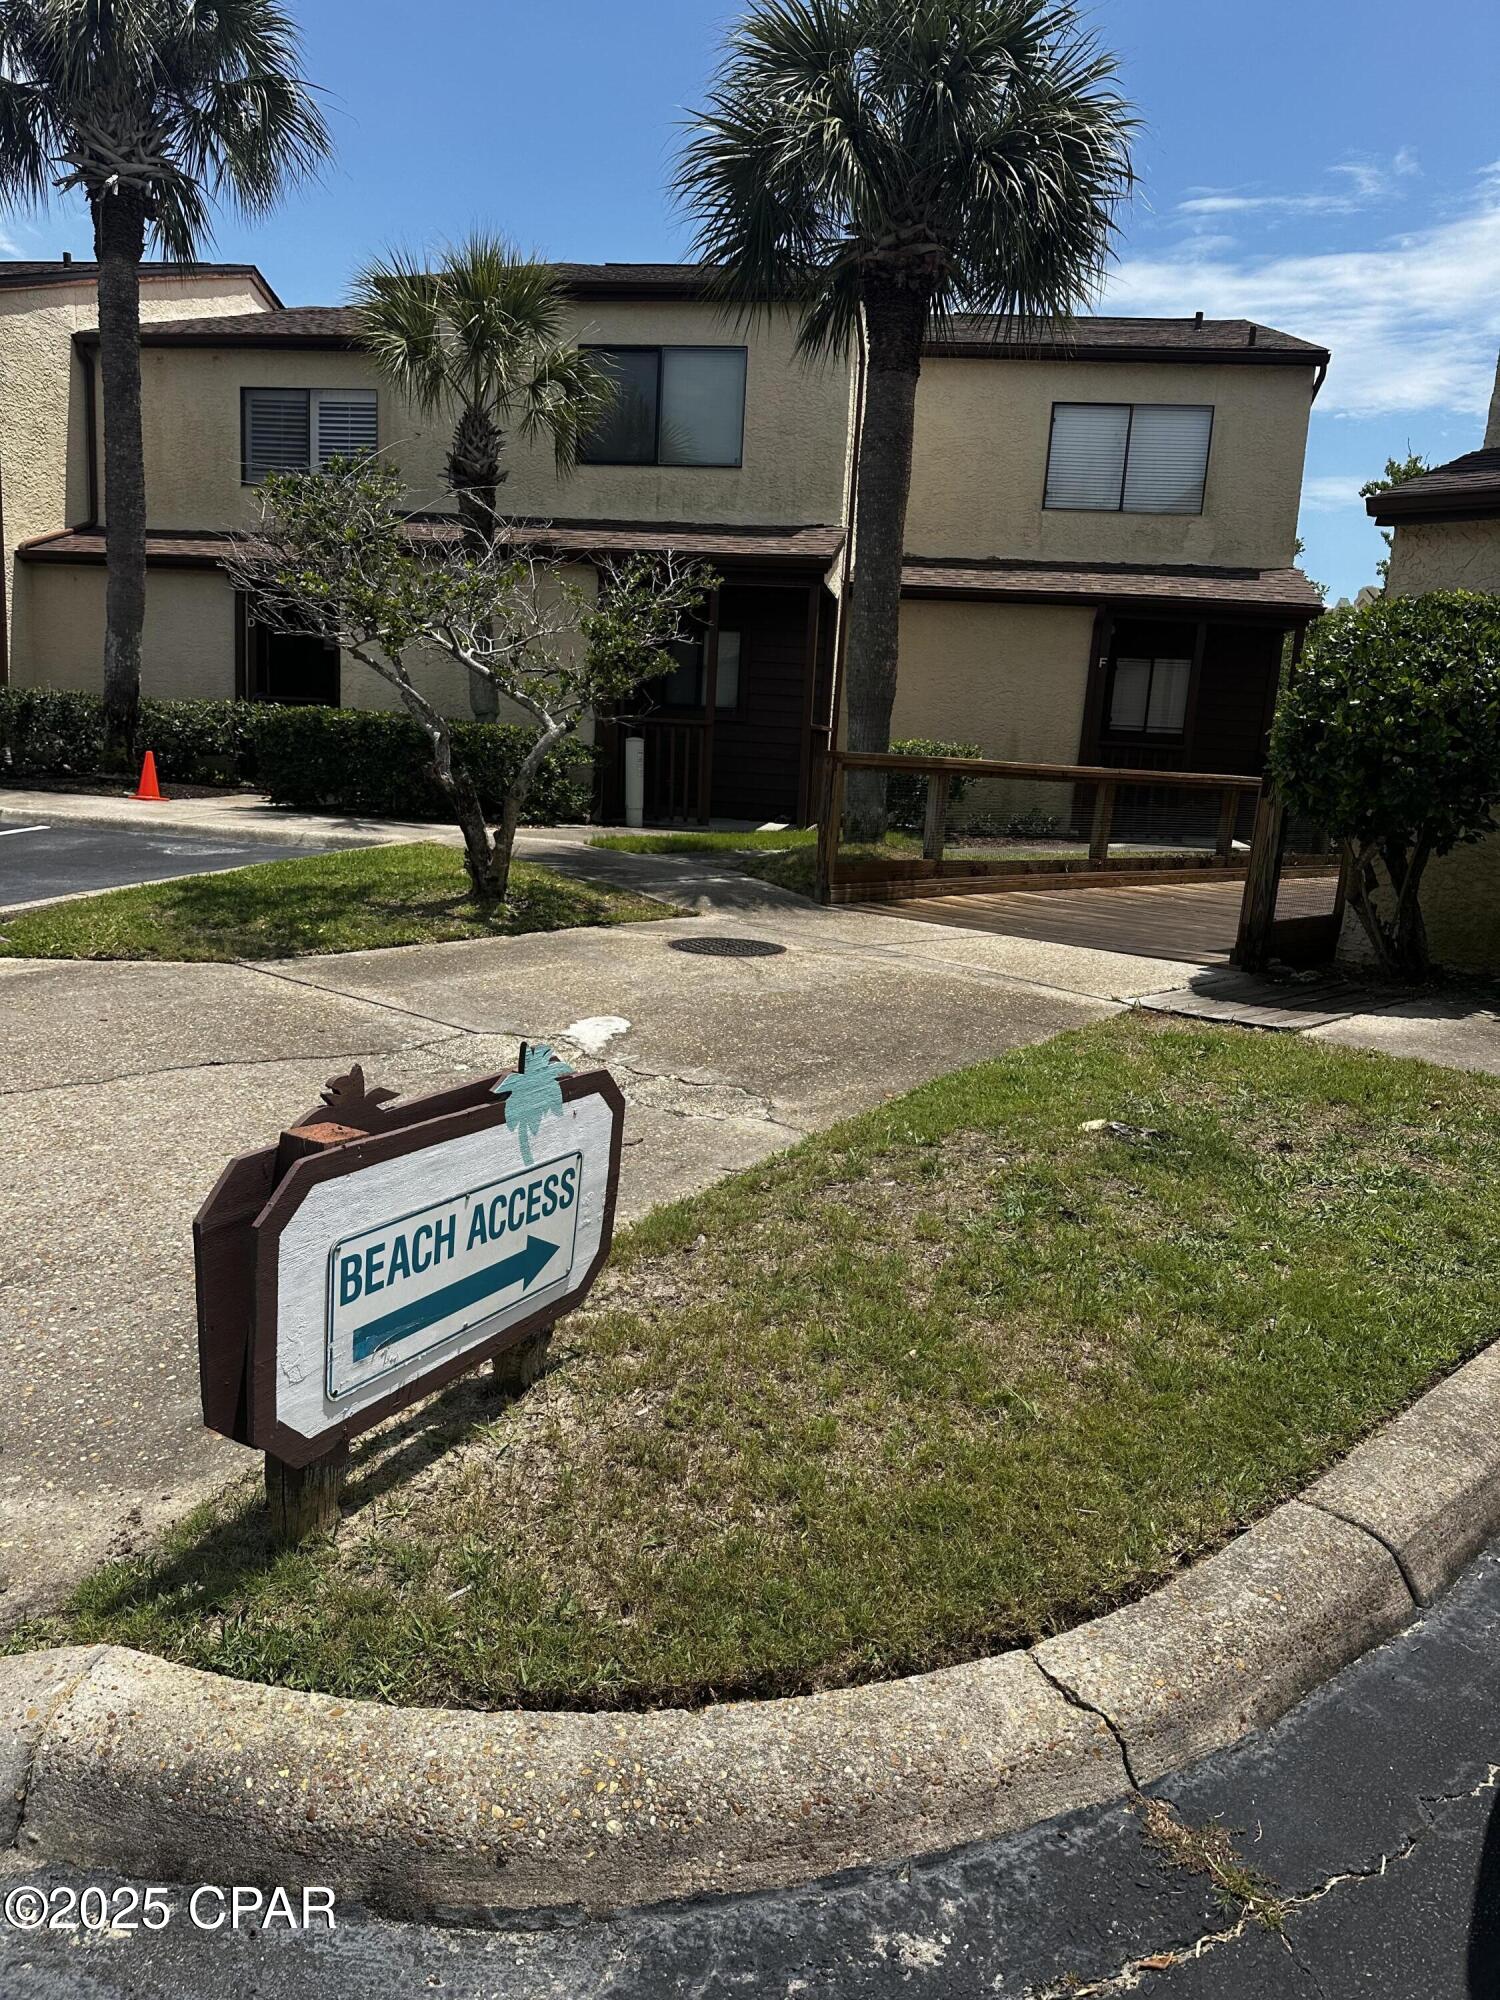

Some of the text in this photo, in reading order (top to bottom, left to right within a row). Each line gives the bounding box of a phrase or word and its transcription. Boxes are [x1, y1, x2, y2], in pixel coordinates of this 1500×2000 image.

[247, 617, 256, 627] D
[1098, 657, 1108, 668] F
[339, 1167, 576, 1307] BEACH ACCESS
